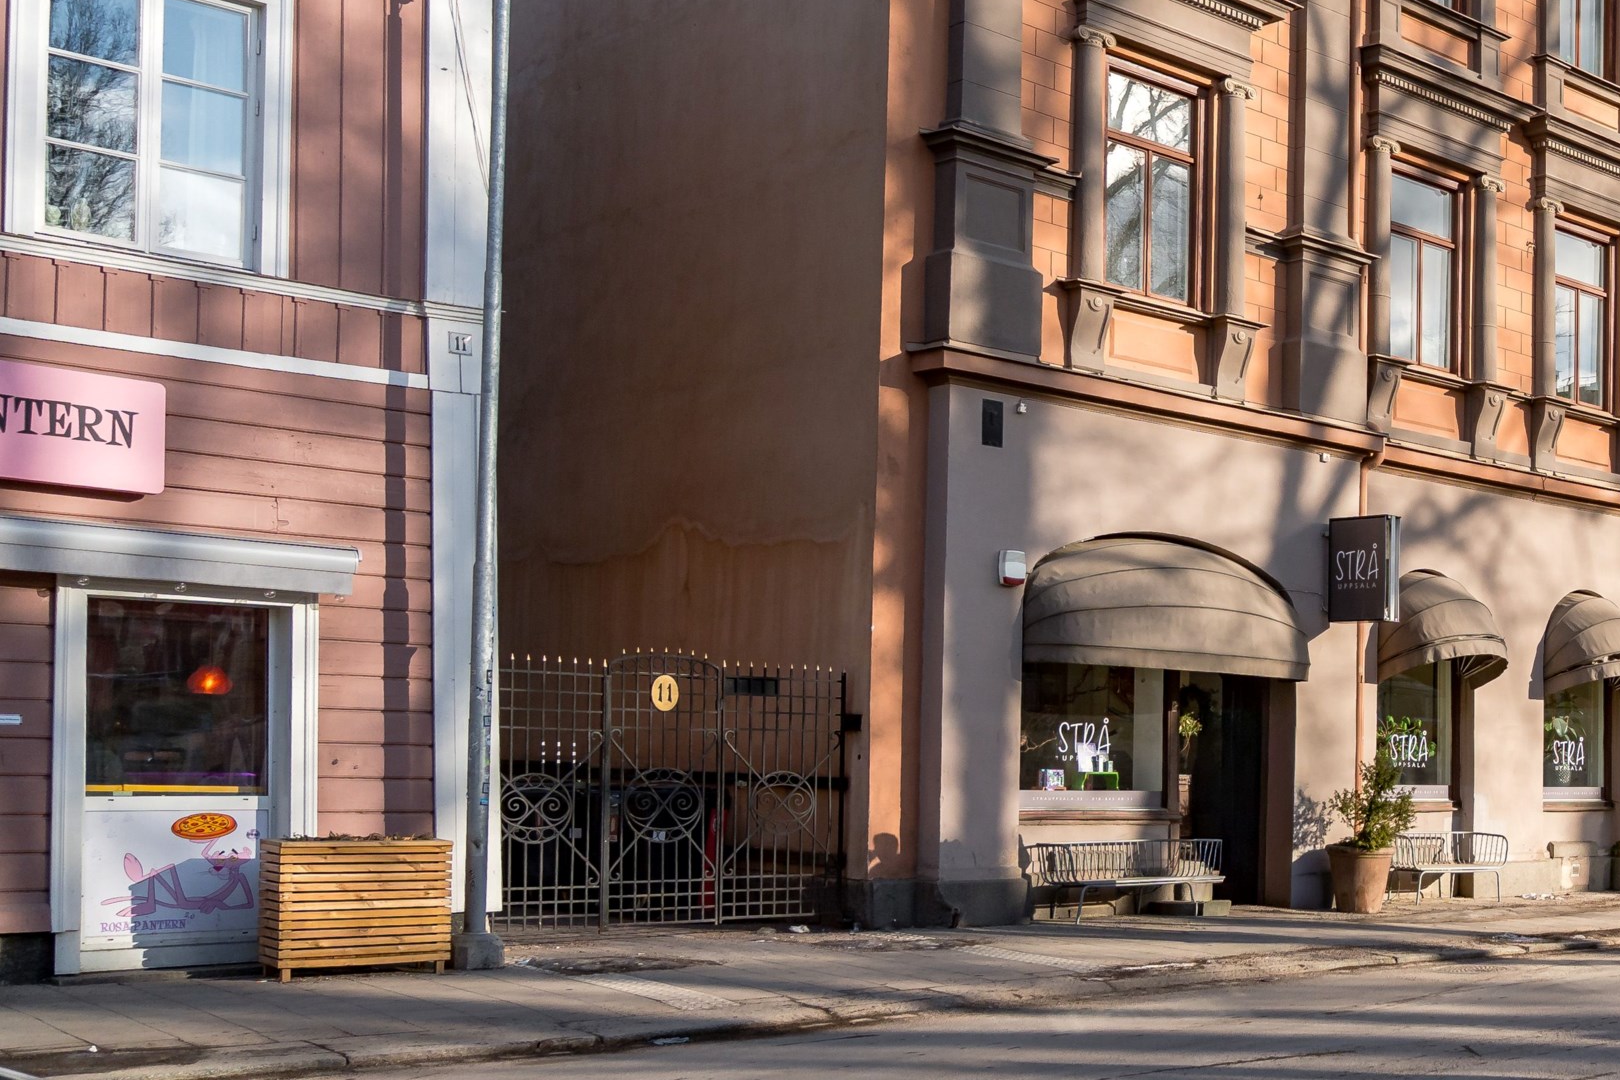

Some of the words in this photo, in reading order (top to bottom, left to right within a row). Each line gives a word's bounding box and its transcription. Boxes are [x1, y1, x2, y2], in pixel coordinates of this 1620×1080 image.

[455, 336, 466, 352] 11
[1335, 542, 1379, 581] STRÅ
[1337, 582, 1377, 590] UPPSALA
[658, 683, 672, 703] 11
[1058, 717, 1111, 753] STRÅ
[1390, 730, 1428, 762] STRÅ
[1552, 736, 1585, 766] STRÅ
[1061, 754, 1109, 763] UPLA
[100, 922, 131, 933] ROSA
[133, 919, 187, 931] PANTERN
